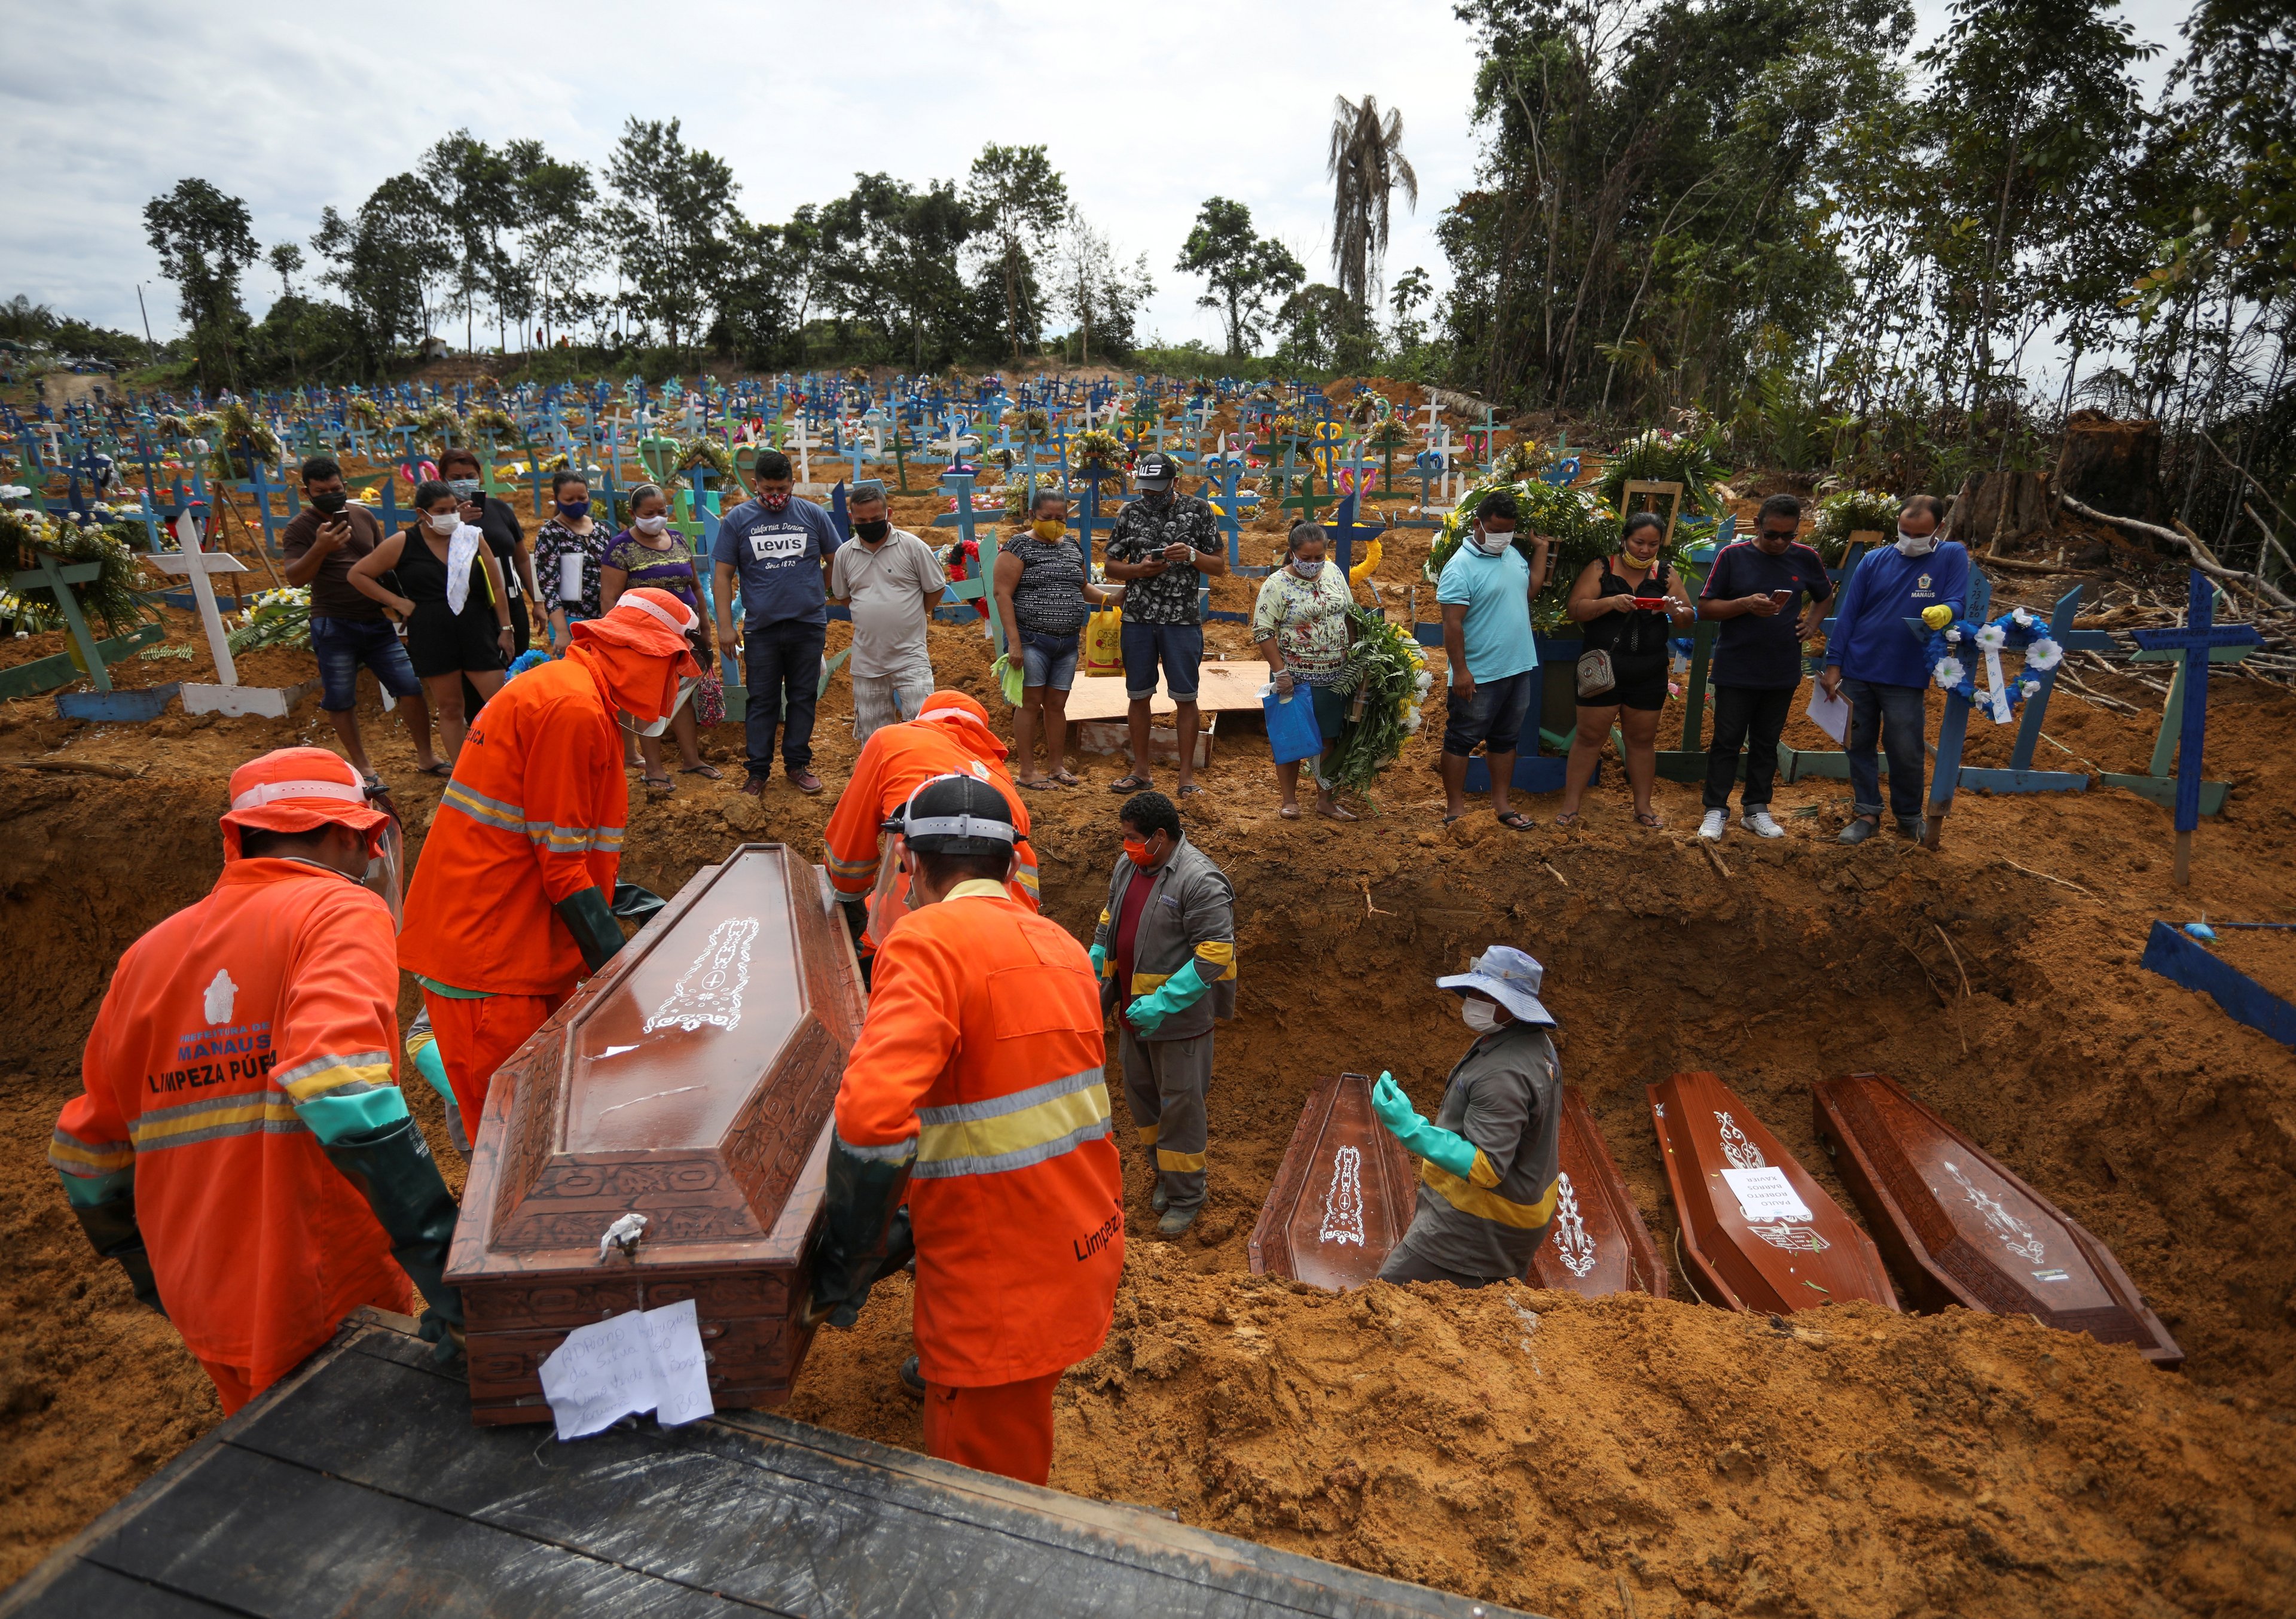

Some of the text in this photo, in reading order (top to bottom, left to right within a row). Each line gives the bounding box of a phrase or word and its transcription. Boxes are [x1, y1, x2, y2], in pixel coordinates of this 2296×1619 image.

[750, 522, 804, 535] California Denim
[1097, 629, 1118, 639] Casa
[180, 1022, 271, 1043] PREFEITURA DE
[178, 1034, 271, 1062] MANAUS
[148, 1063, 226, 1093] LIMPEZA
[1073, 1211, 1121, 1263] Limpeza
